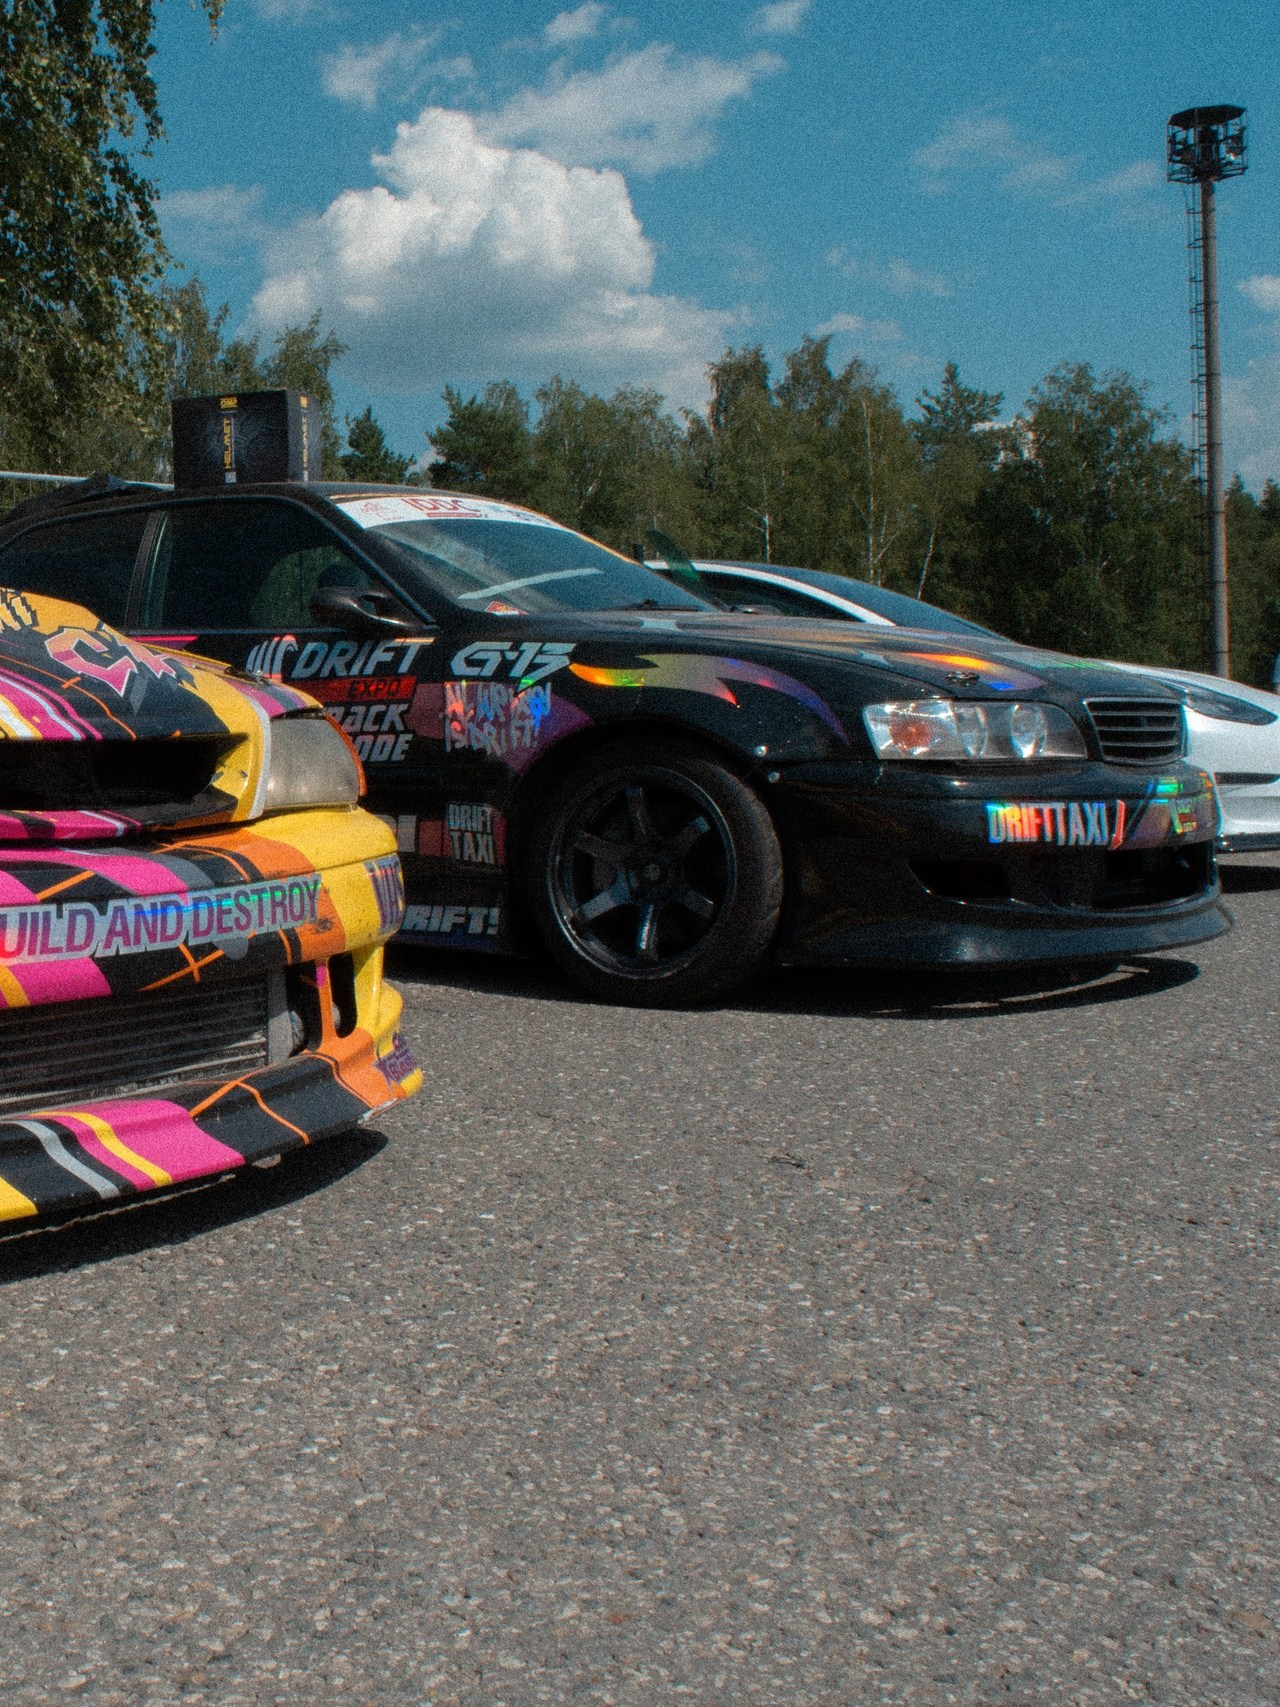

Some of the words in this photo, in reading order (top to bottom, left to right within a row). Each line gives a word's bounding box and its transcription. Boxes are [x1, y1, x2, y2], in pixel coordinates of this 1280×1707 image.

[291, 637, 435, 679] DRIFT
[349, 680, 401, 697] EXPO
[448, 804, 492, 833] DRIFT
[450, 831, 494, 864] TAXI
[100, 896, 183, 950] AND
[192, 880, 320, 938] DESTROY
[400, 905, 499, 934] RIFT!
